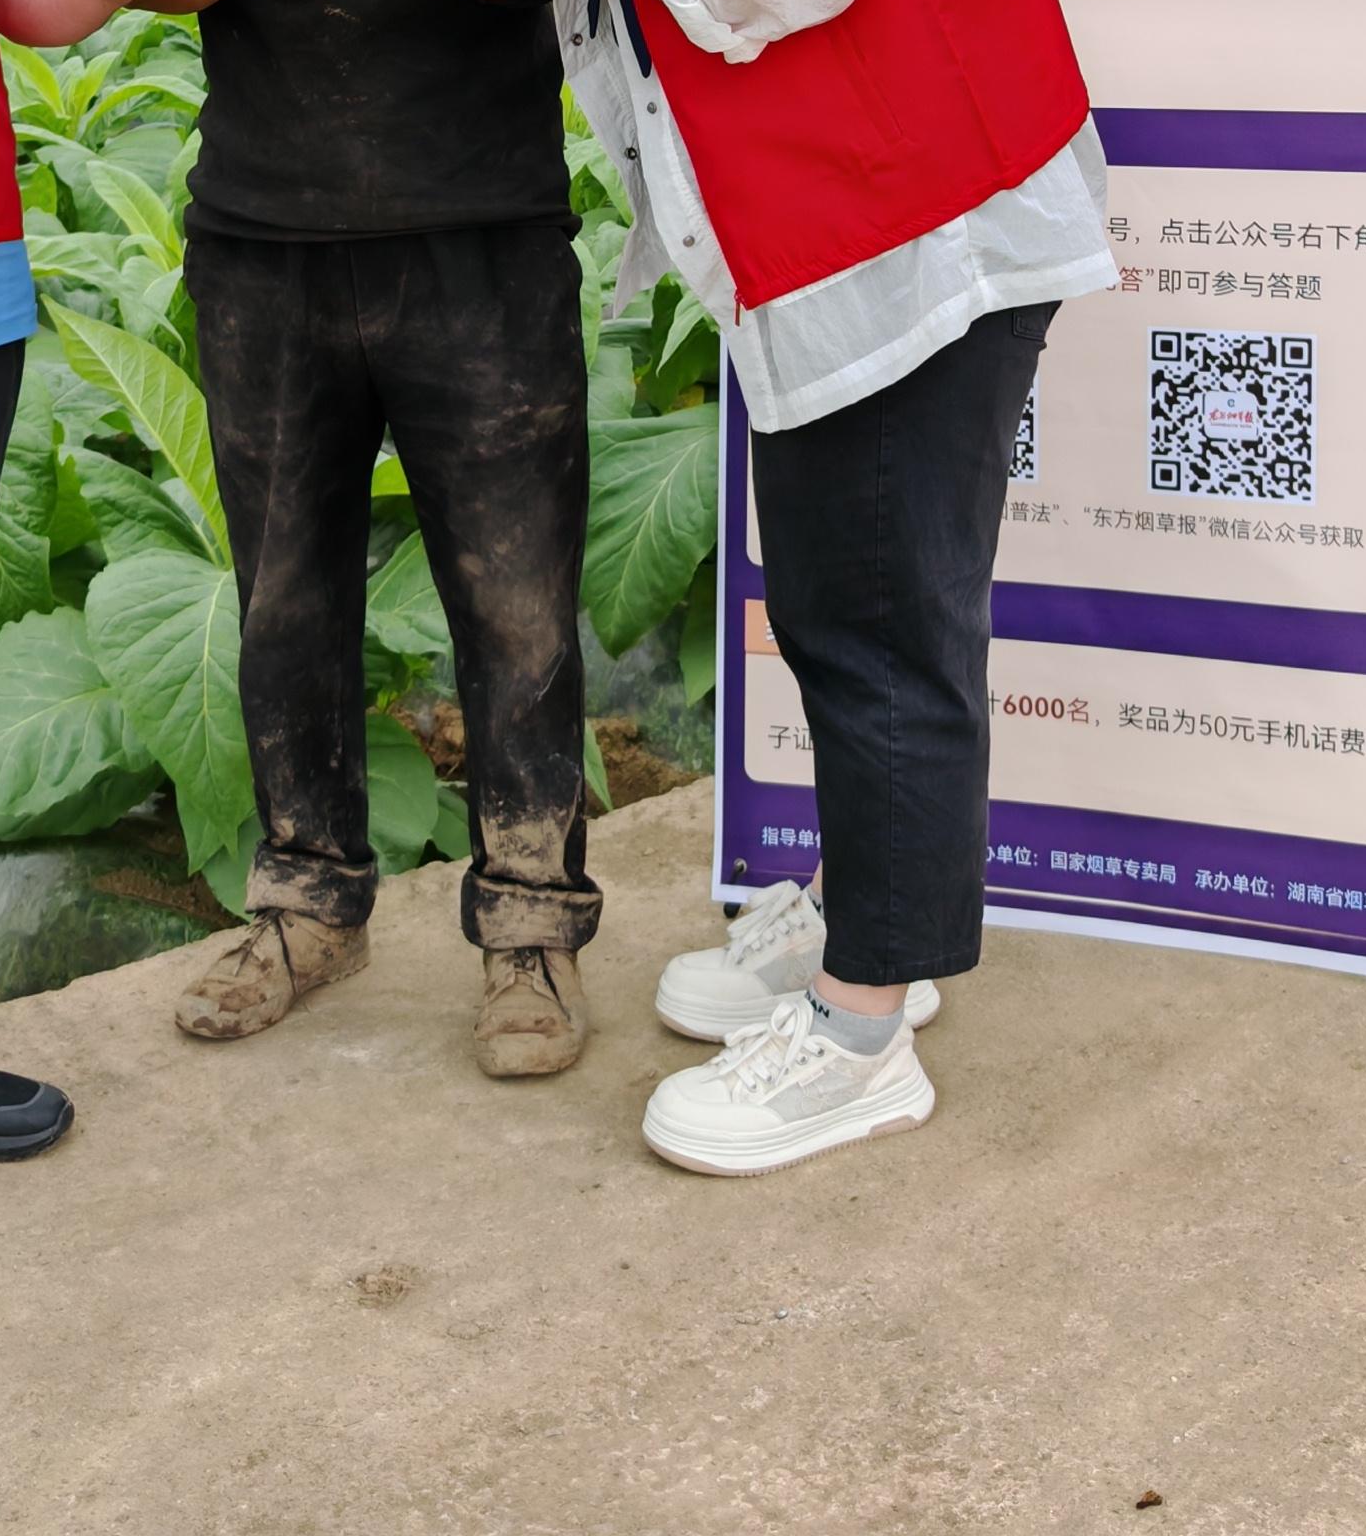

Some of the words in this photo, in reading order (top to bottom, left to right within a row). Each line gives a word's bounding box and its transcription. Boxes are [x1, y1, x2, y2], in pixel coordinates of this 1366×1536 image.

[1106, 267, 1322, 302] 答”即可参与答题
[1001, 500, 1364, 549] 普法”、“东方烟草报”微信公众号获取
